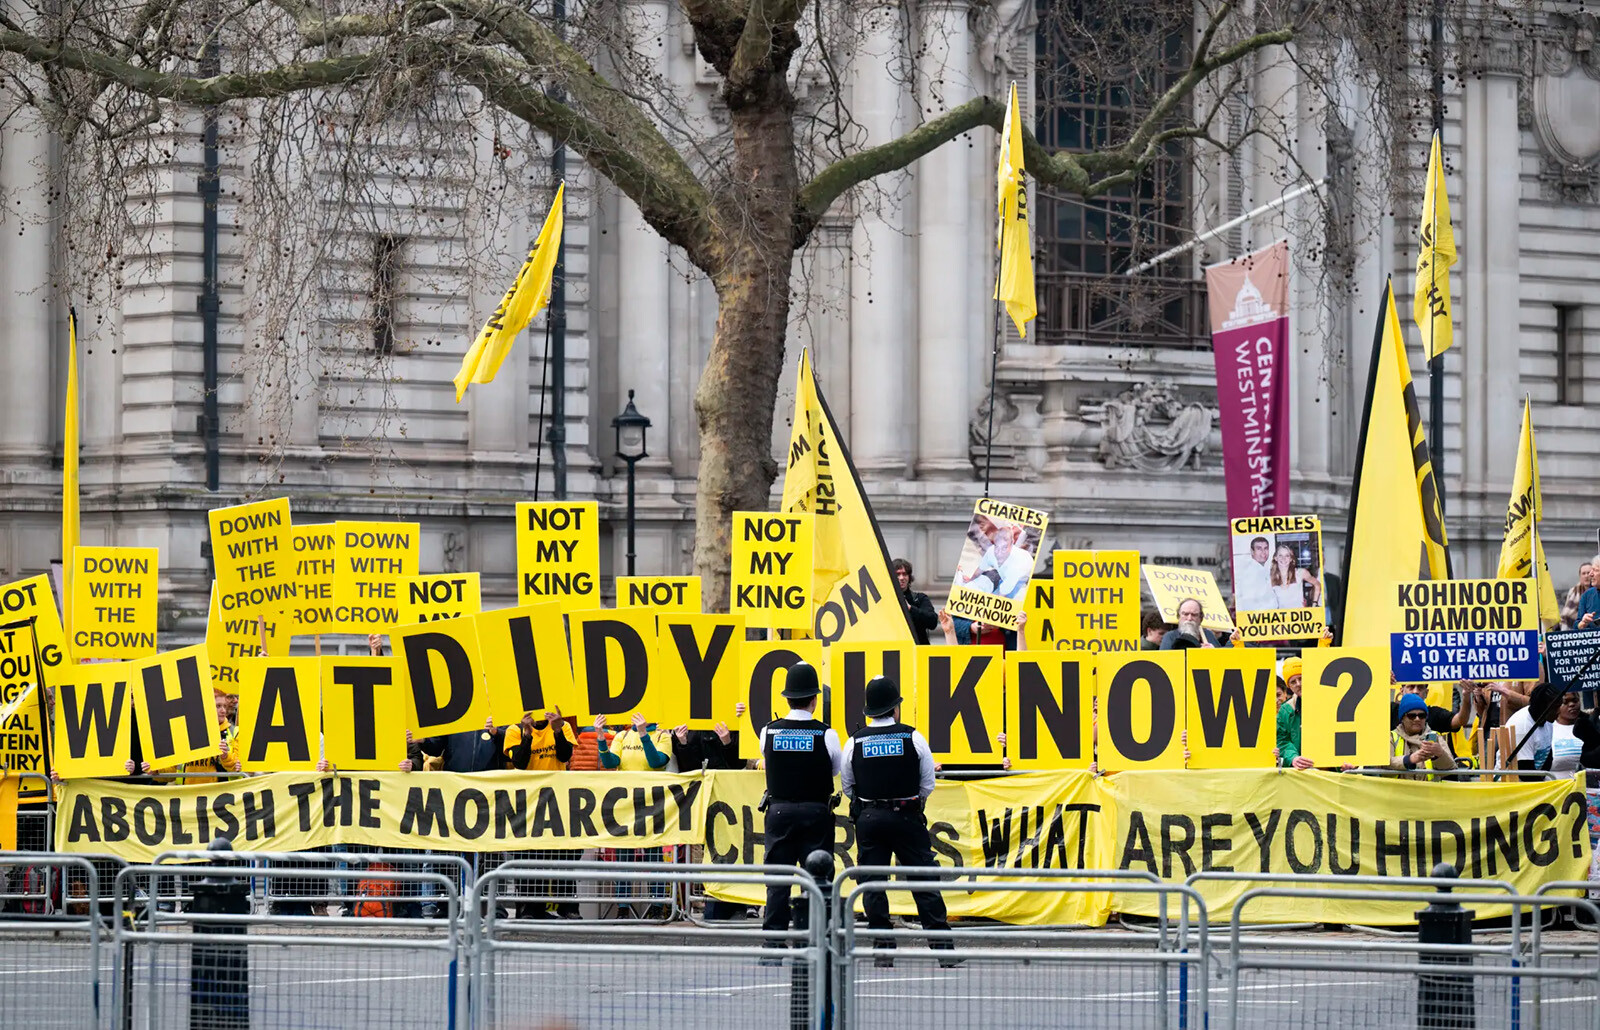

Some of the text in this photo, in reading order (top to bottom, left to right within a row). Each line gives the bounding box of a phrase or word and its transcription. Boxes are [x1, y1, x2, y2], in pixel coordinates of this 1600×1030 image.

[529, 508, 585, 531] NOT
[978, 499, 1043, 526] CHARLES
[220, 510, 282, 536] DOWN
[745, 518, 801, 542] NOT
[1235, 516, 1315, 533] CHARLES
[228, 535, 278, 559] WITH
[293, 535, 335, 551] OWN
[345, 532, 410, 549] DOWN
[536, 540, 579, 563] MY
[84, 557, 148, 574] DOWN
[236, 561, 276, 582] THE
[350, 558, 402, 574] WITH
[750, 552, 793, 575] MY
[1064, 561, 1130, 578] DOWN
[524, 572, 593, 596] KING
[1154, 571, 1208, 584] DOWN
[89, 582, 141, 598] WITH
[222, 582, 297, 611] CROWN
[299, 583, 332, 599] HE
[355, 582, 396, 598] THE
[410, 579, 466, 604] NOT
[629, 583, 688, 605] NOT
[737, 585, 805, 610] KING
[1070, 587, 1123, 604] WITH
[1163, 583, 1208, 597] WITH
[1398, 581, 1528, 607] KOHINOOR
[960, 590, 1012, 612] WHAT DID
[1175, 596, 1209, 609] TE
[94, 607, 135, 623] THE
[293, 608, 333, 624] ROW
[336, 606, 398, 624] CROW
[949, 600, 1018, 626] YOU KNOW?
[1076, 613, 1117, 630] THE
[1163, 607, 1230, 623] CWN
[1247, 611, 1312, 624] WHAT DID
[1405, 606, 1522, 631] DIAMOND
[1239, 622, 1322, 637] YOU KNOW?
[74, 631, 154, 648] CROWN
[1056, 638, 1138, 652] CROWN
[1403, 631, 1526, 648] STOLEN FROM
[1401, 647, 1529, 664] A 10 YEAR OLD
[1550, 650, 1561, 658] WE
[1563, 647, 1595, 657] DEMAND
[1555, 658, 1570, 666] FOR
[1573, 656, 1588, 664] THE
[1422, 664, 1509, 679] SIKH KING
[775, 740, 812, 750] POLICE
[864, 745, 902, 756] POLICE
[68, 778, 702, 846] ABOLISH THE MONARCHY
[978, 803, 1101, 869] WHAT
[1119, 811, 1235, 878] ARE
[1244, 809, 1360, 875] YOU
[1375, 792, 1587, 878] HIDING?
